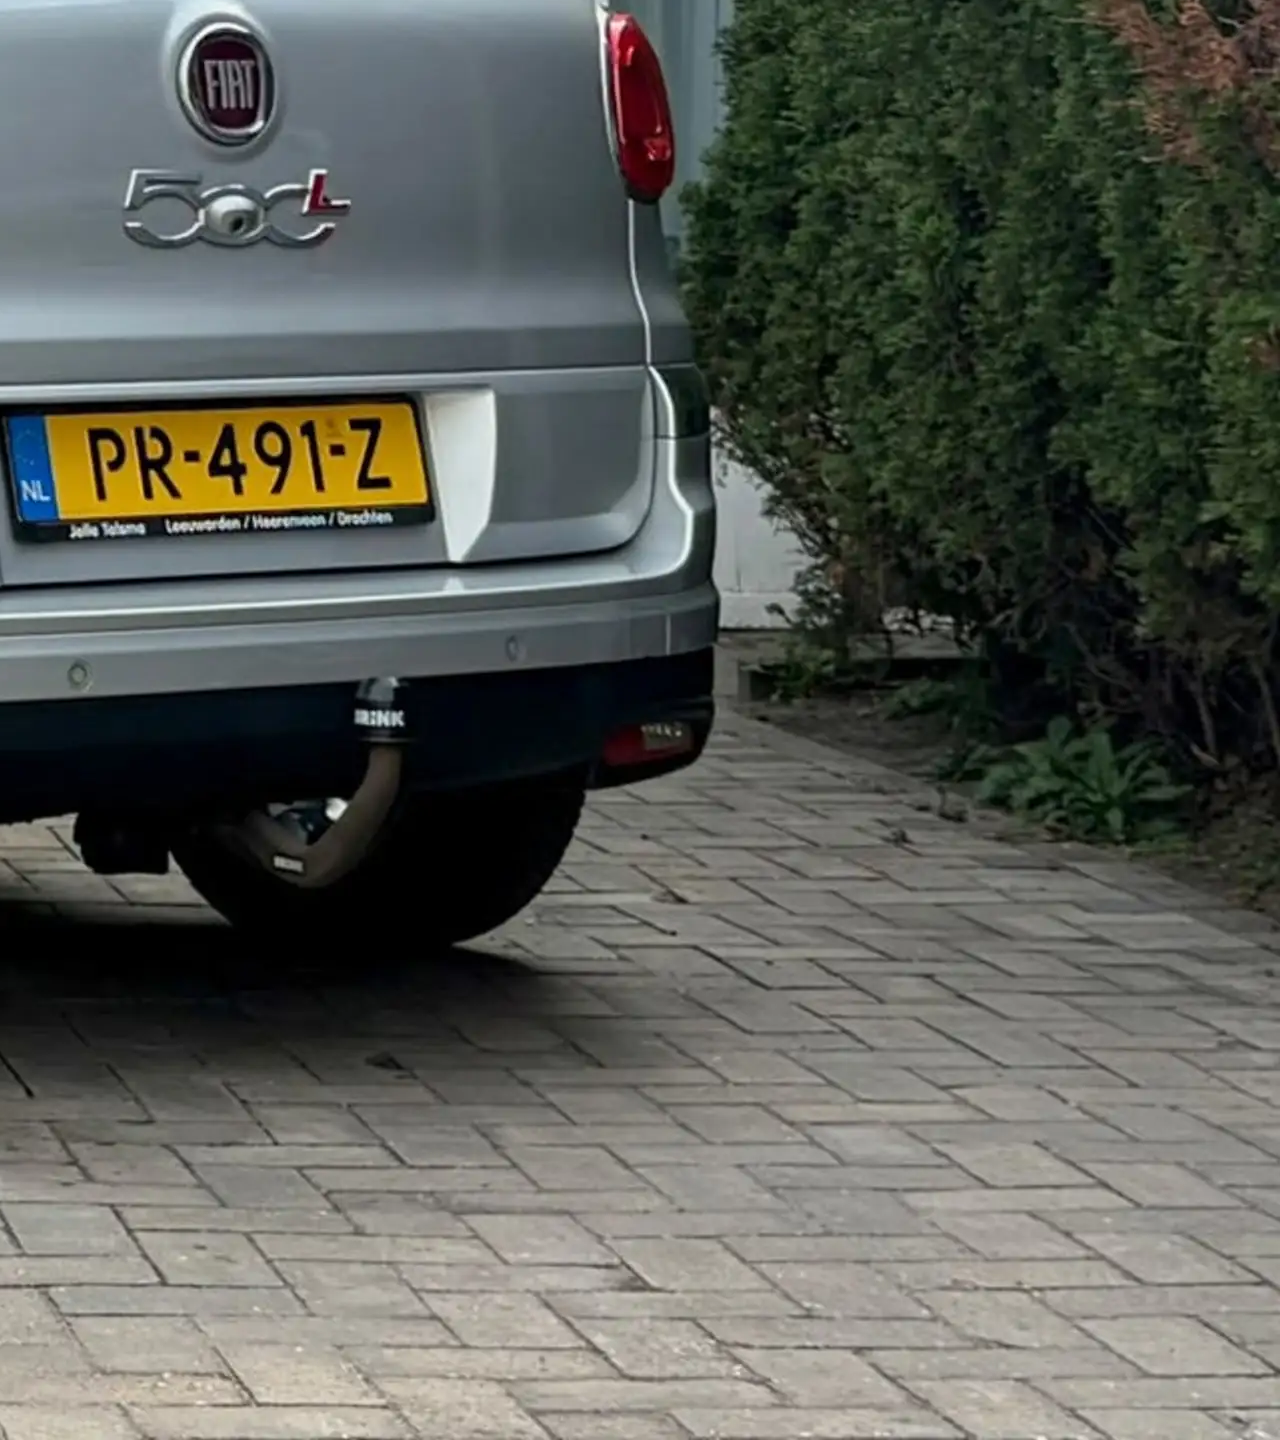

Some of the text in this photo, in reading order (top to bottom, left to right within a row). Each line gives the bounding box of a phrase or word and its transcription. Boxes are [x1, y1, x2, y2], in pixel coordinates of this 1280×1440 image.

[203, 59, 256, 110] FIAT
[122, 168, 352, 250] 500L
[86, 417, 393, 502] PR-491-Z
[20, 479, 51, 502] NL
[164, 515, 241, 534] Leeuwarden
[337, 509, 393, 527] Drachten
